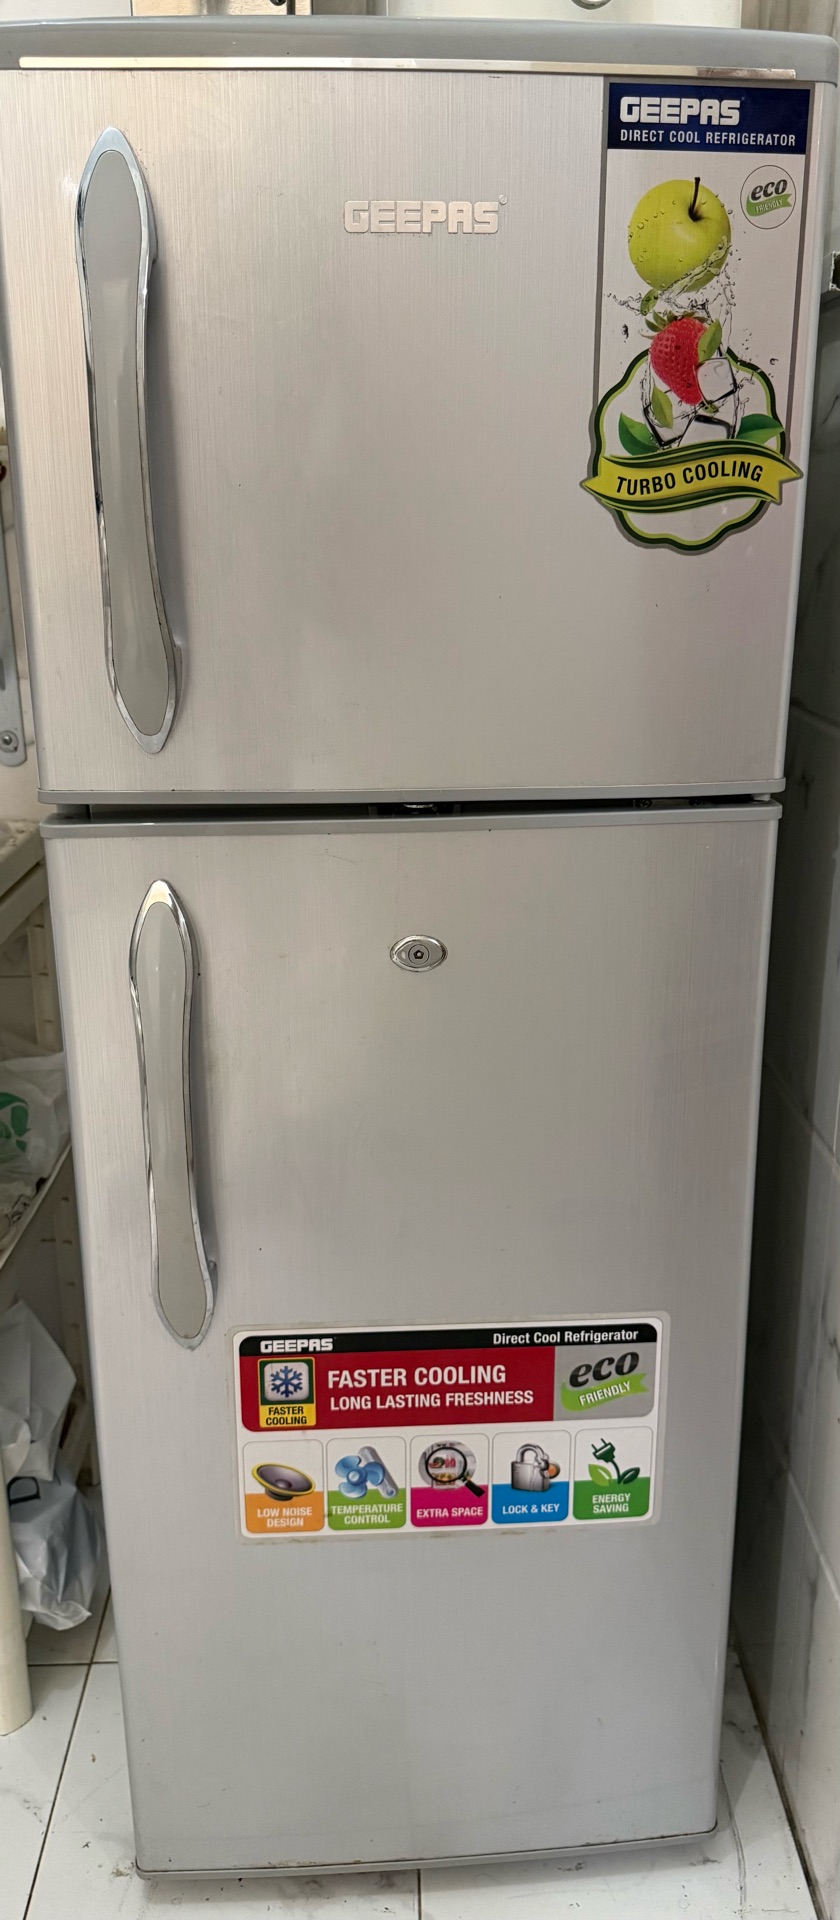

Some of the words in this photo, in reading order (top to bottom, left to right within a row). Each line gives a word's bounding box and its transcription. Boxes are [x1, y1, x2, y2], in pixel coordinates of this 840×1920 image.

[620, 97, 740, 126] GEEPAS
[620, 130, 664, 143] DIRECT
[669, 131, 700, 144] COOL
[706, 132, 796, 146] REFRIGERATOR
[751, 179, 788, 201] eco
[344, 200, 499, 234] GEEPAS
[616, 472, 676, 496] TURBO
[682, 460, 764, 484] COOLING
[493, 1332, 530, 1345] Direct
[534, 1332, 560, 1343] Cool
[564, 1330, 638, 1344] Refrigerator
[260, 1338, 334, 1353] GEEPAS
[328, 1368, 407, 1389] FASTER
[414, 1364, 506, 1386] COOLING
[569, 1352, 640, 1388] eco
[330, 1396, 372, 1411] LONG
[376, 1393, 440, 1409] LASTING
[446, 1390, 534, 1406] FRESHNESS
[578, 1381, 631, 1406] FRIENDLY
[268, 1406, 304, 1416] FASTER
[266, 1416, 307, 1426] COOLING
[592, 1494, 631, 1504] ENERGY
[257, 1508, 280, 1518] LOW
[282, 1507, 312, 1516] NOISE
[331, 1504, 403, 1514] TEMPERATURE
[416, 1508, 449, 1518] EXTRA
[451, 1506, 484, 1516] SPACE
[502, 1505, 528, 1514] LOCK
[530, 1505, 538, 1513] &
[541, 1504, 560, 1512] KEY
[593, 1503, 629, 1514] SAVING
[266, 1518, 304, 1528] DESIGN
[344, 1514, 390, 1524] CONTROL
